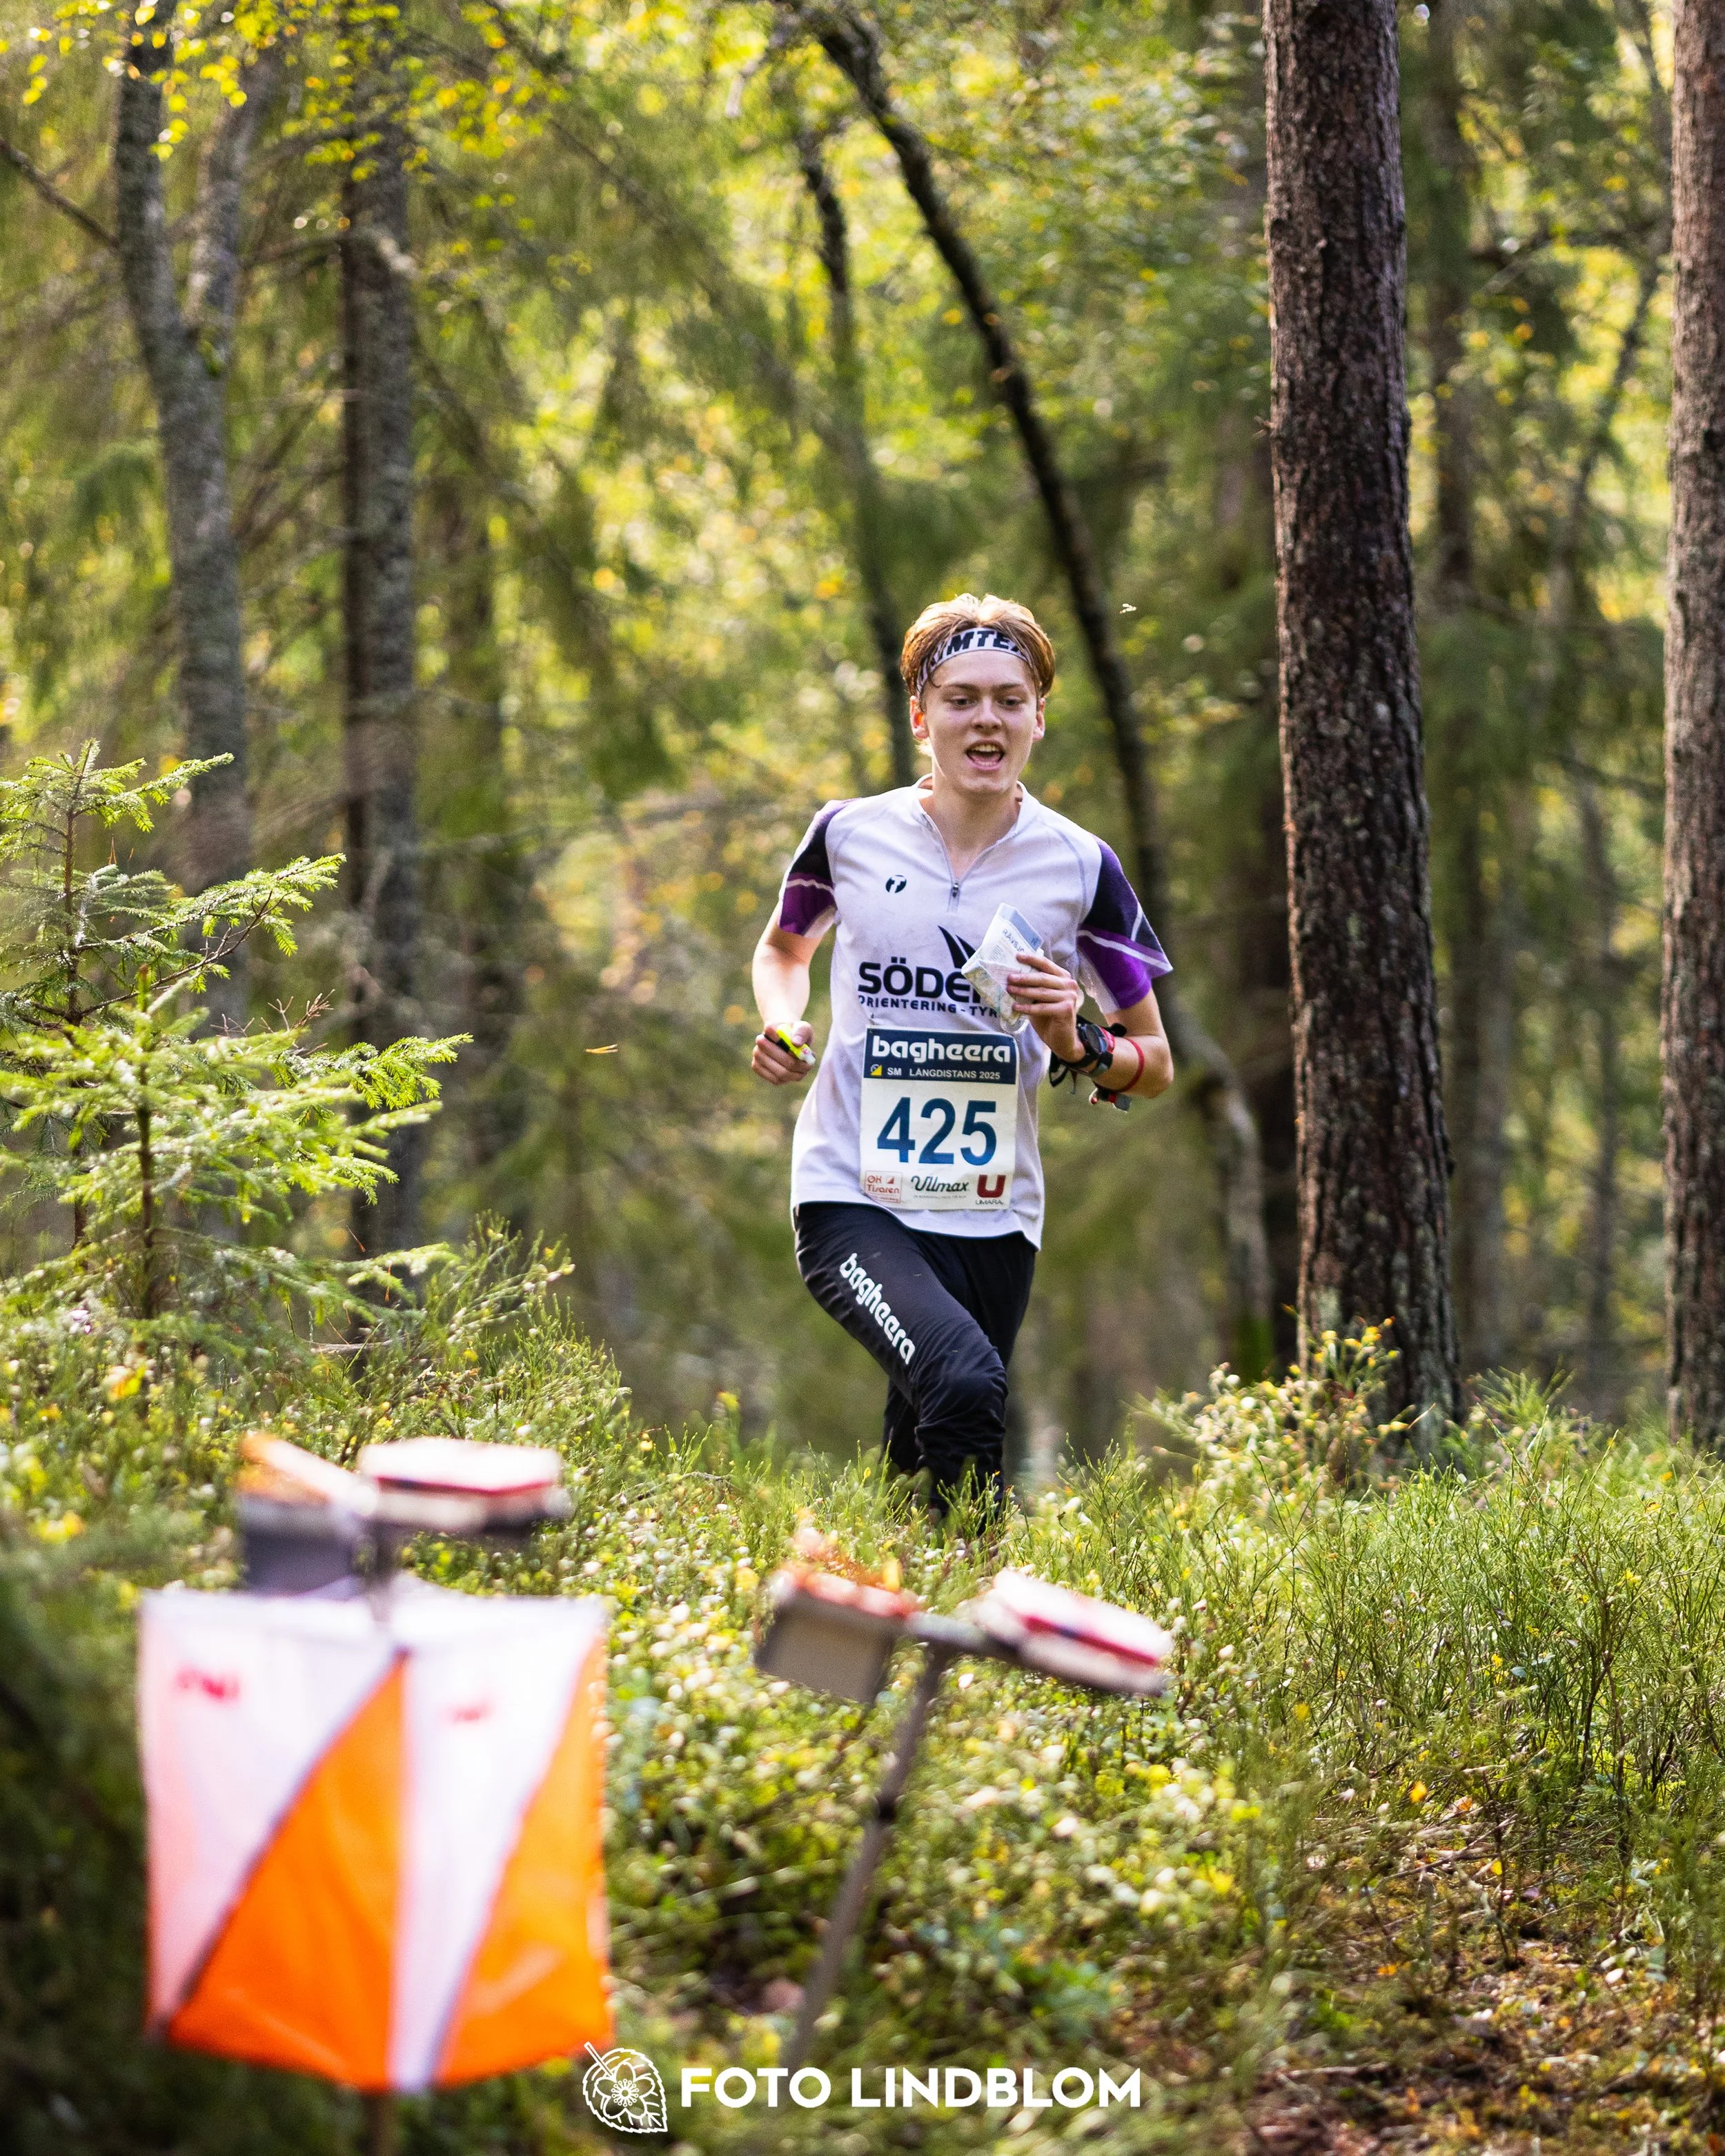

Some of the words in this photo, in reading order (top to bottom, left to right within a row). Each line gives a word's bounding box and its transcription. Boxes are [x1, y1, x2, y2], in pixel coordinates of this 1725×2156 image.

[858, 956, 980, 1003] SÖDE
[872, 1035, 1011, 1063] bagheera
[887, 1067, 902, 1076] SM
[877, 1097, 997, 1166] 425
[911, 1176, 969, 1192] Ullmax
[839, 1252, 916, 1365] bagheera
